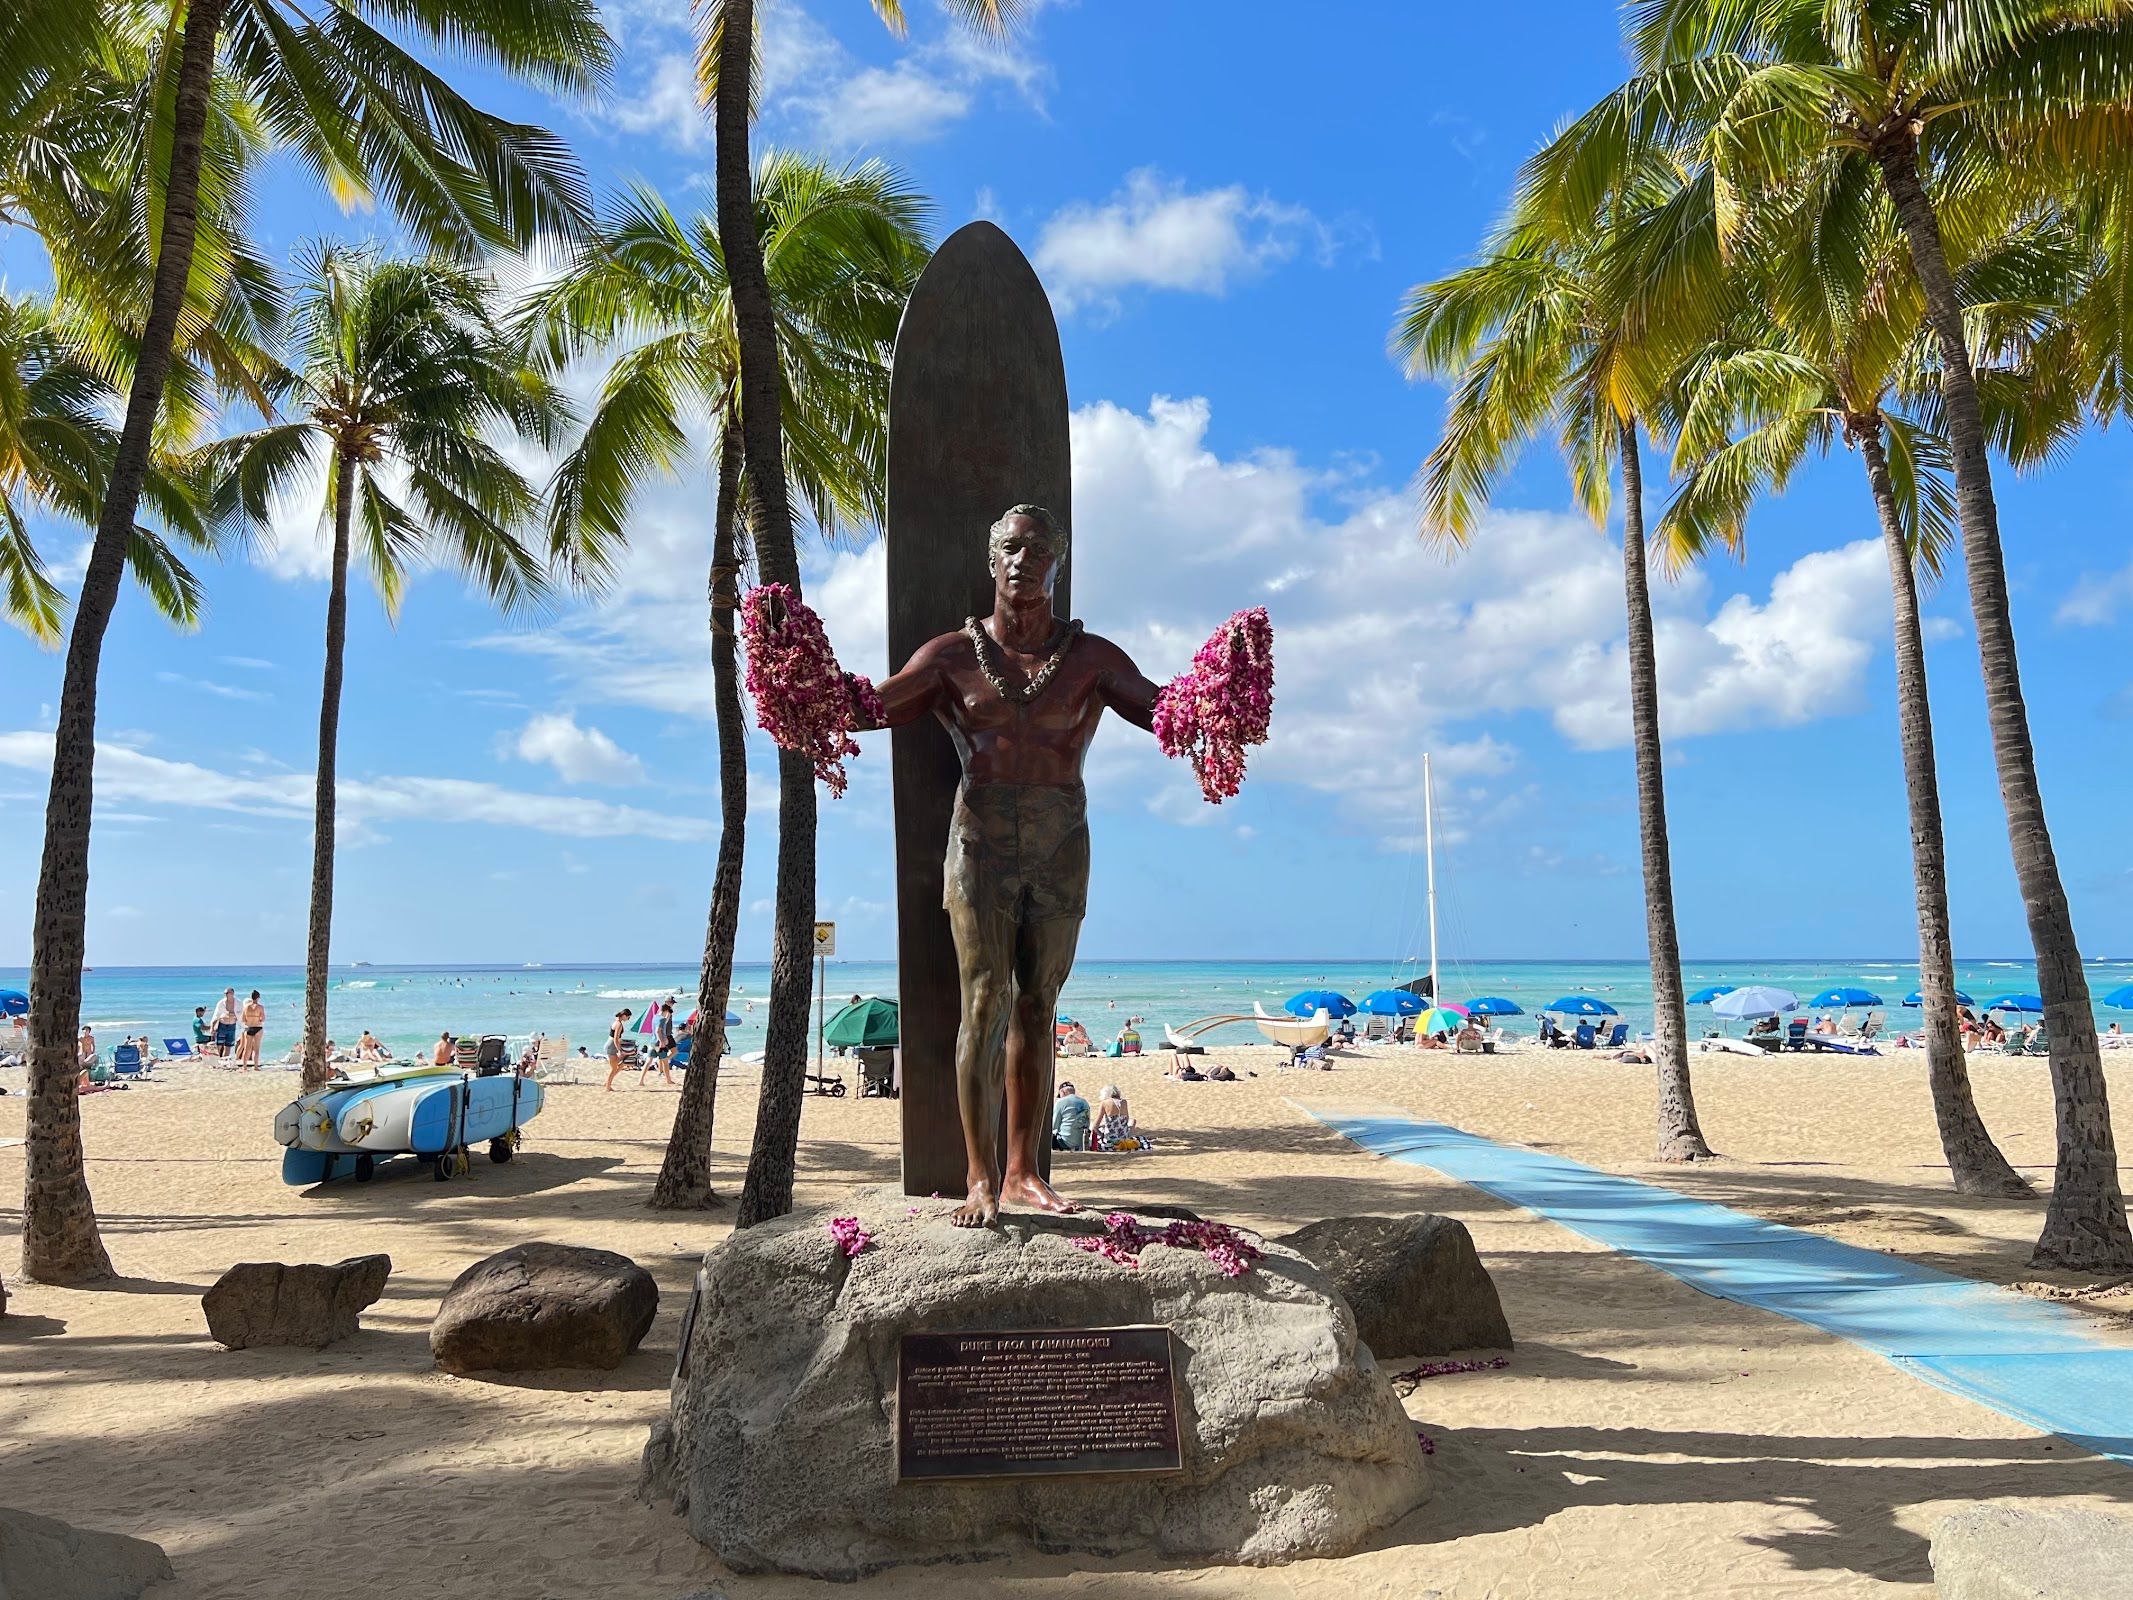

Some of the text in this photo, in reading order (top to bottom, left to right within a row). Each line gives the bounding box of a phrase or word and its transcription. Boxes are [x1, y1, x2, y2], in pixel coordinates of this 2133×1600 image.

[960, 1337, 1110, 1351] DUKE PAOA KAHANAMOKU
